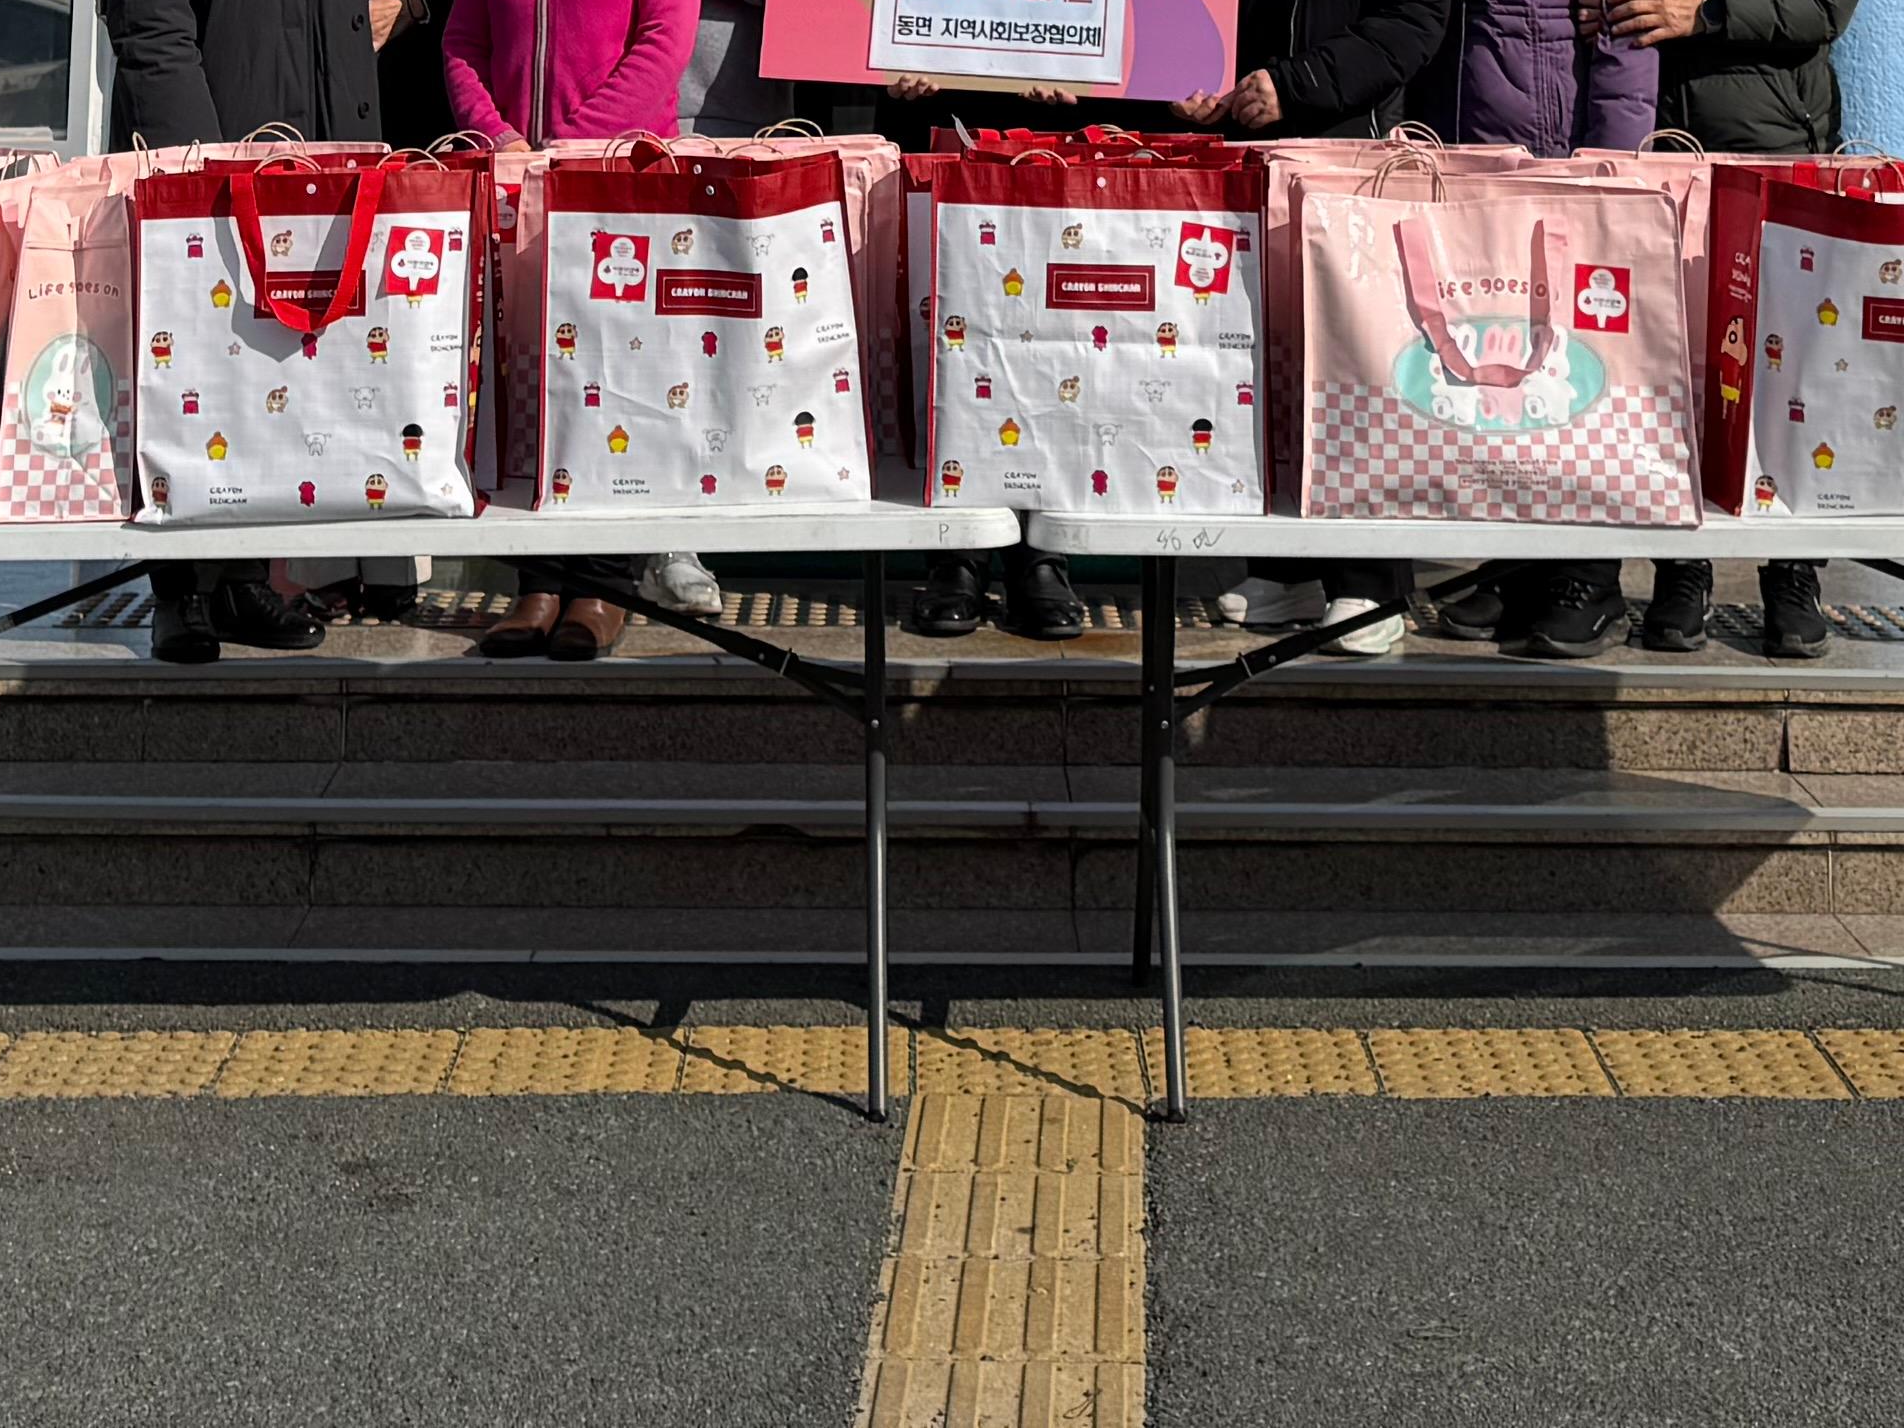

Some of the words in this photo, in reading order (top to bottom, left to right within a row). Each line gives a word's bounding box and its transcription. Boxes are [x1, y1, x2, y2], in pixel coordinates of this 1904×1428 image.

[897, 15, 932, 37] 동면
[941, 17, 1101, 47] 지역사회보장협의체
[28, 282, 64, 300] Life
[69, 281, 100, 295] goes
[103, 283, 119, 297] on
[1438, 281, 1473, 300] ife
[1480, 277, 1528, 294] goes
